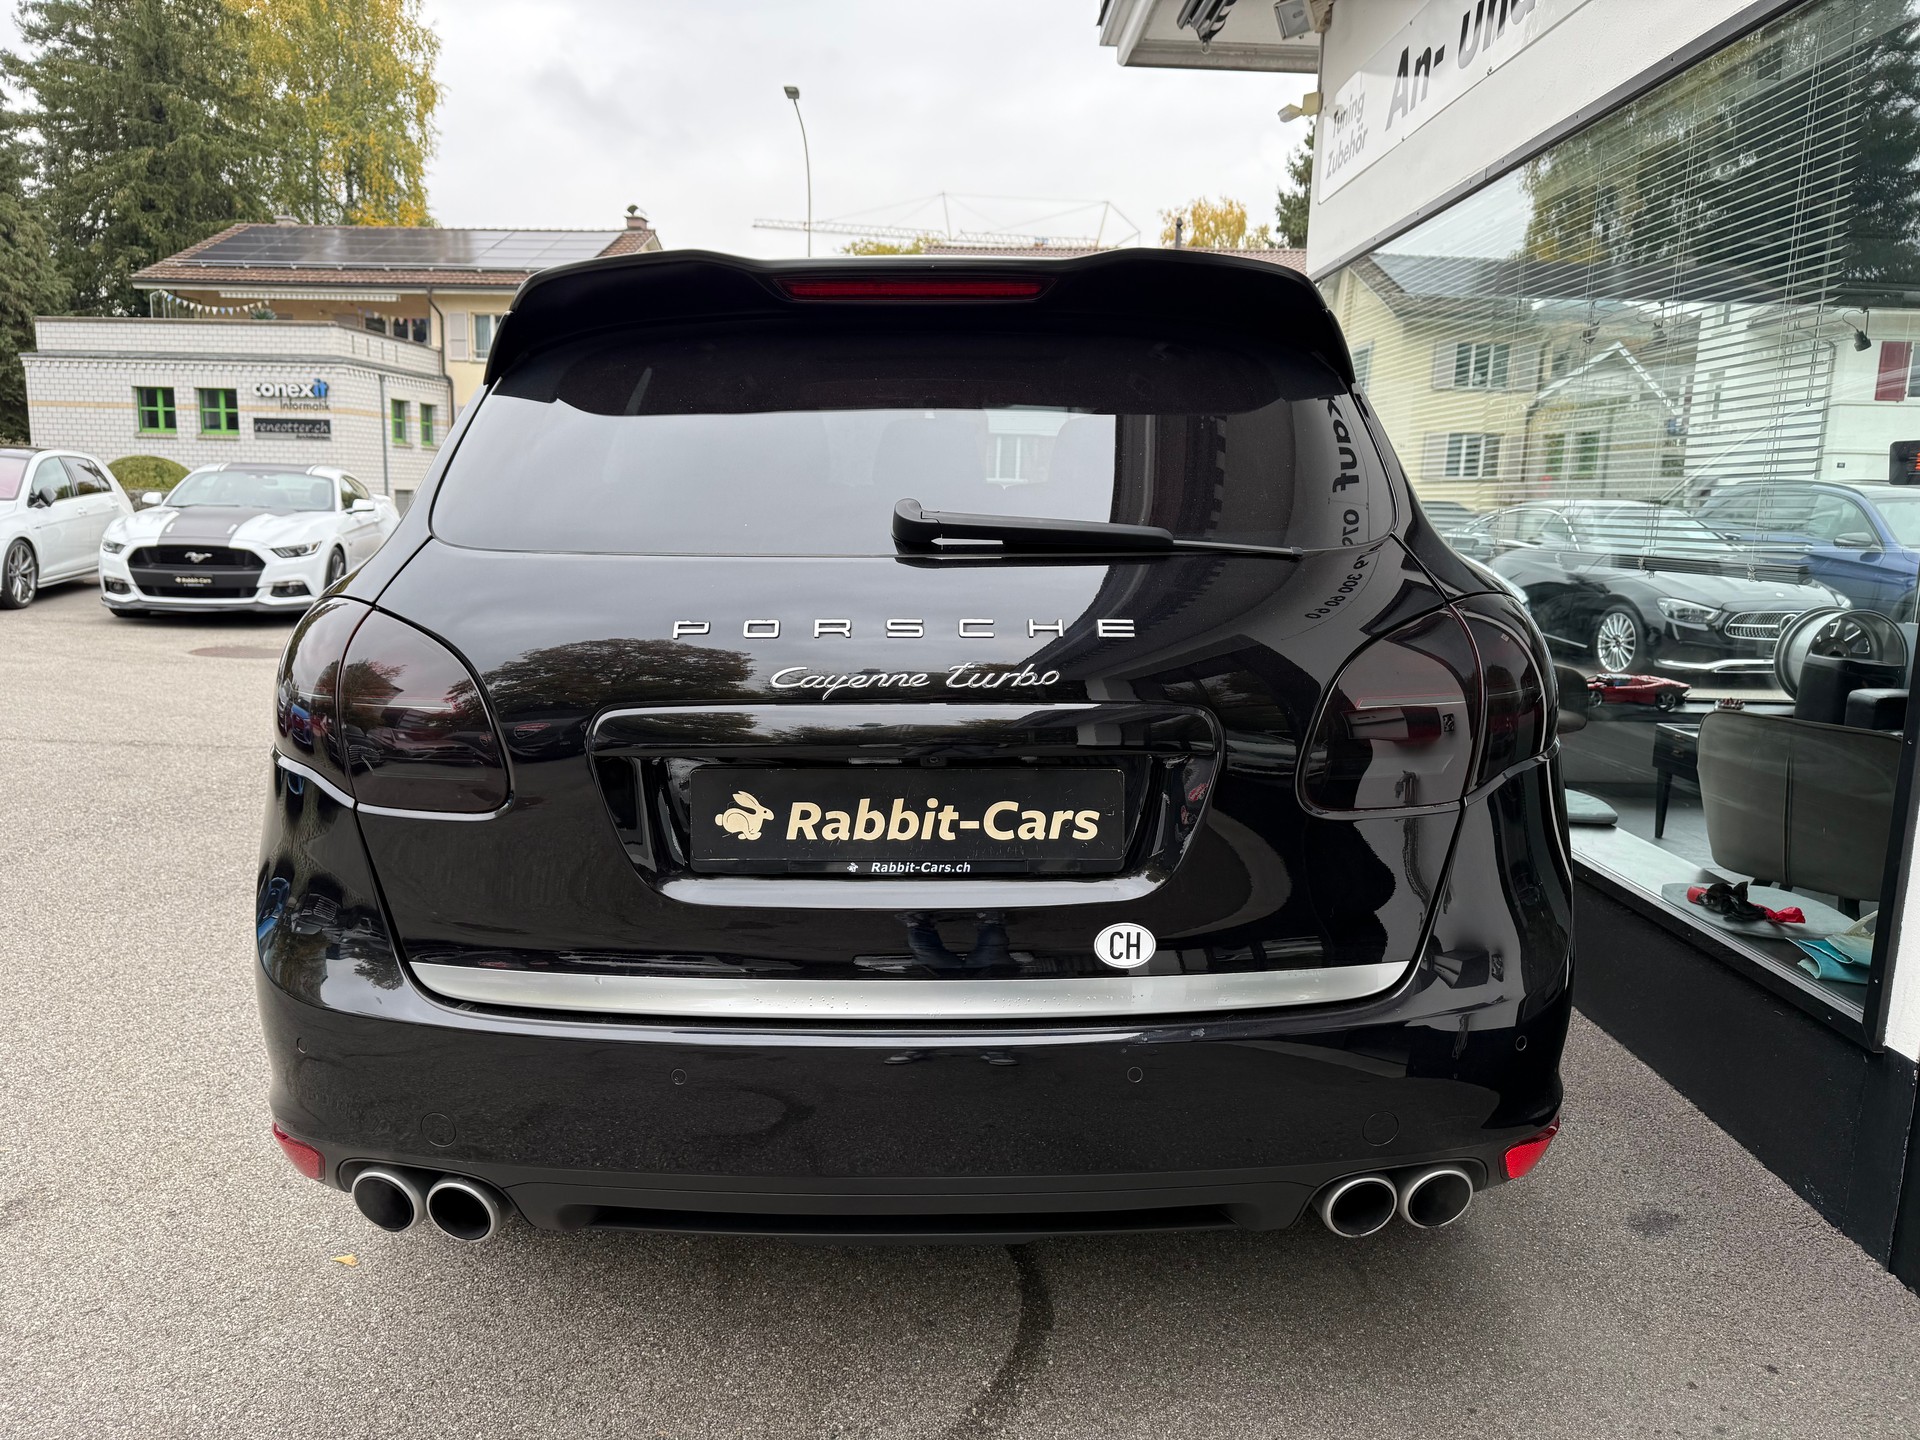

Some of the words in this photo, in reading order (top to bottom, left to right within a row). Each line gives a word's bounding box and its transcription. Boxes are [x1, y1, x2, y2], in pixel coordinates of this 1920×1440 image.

[1385, 44, 1446, 132] An-
[1332, 91, 1365, 138] Tuning
[1326, 122, 1368, 180] Zubehör
[280, 398, 330, 411] Informatik
[672, 618, 1136, 639] PORSCHE
[769, 666, 930, 701] Cayenne
[945, 662, 1061, 688] turbo
[785, 797, 1101, 841] Rabbit-Cars
[871, 861, 971, 873] Rabbit-Cars.ch
[1109, 931, 1141, 960] CH
